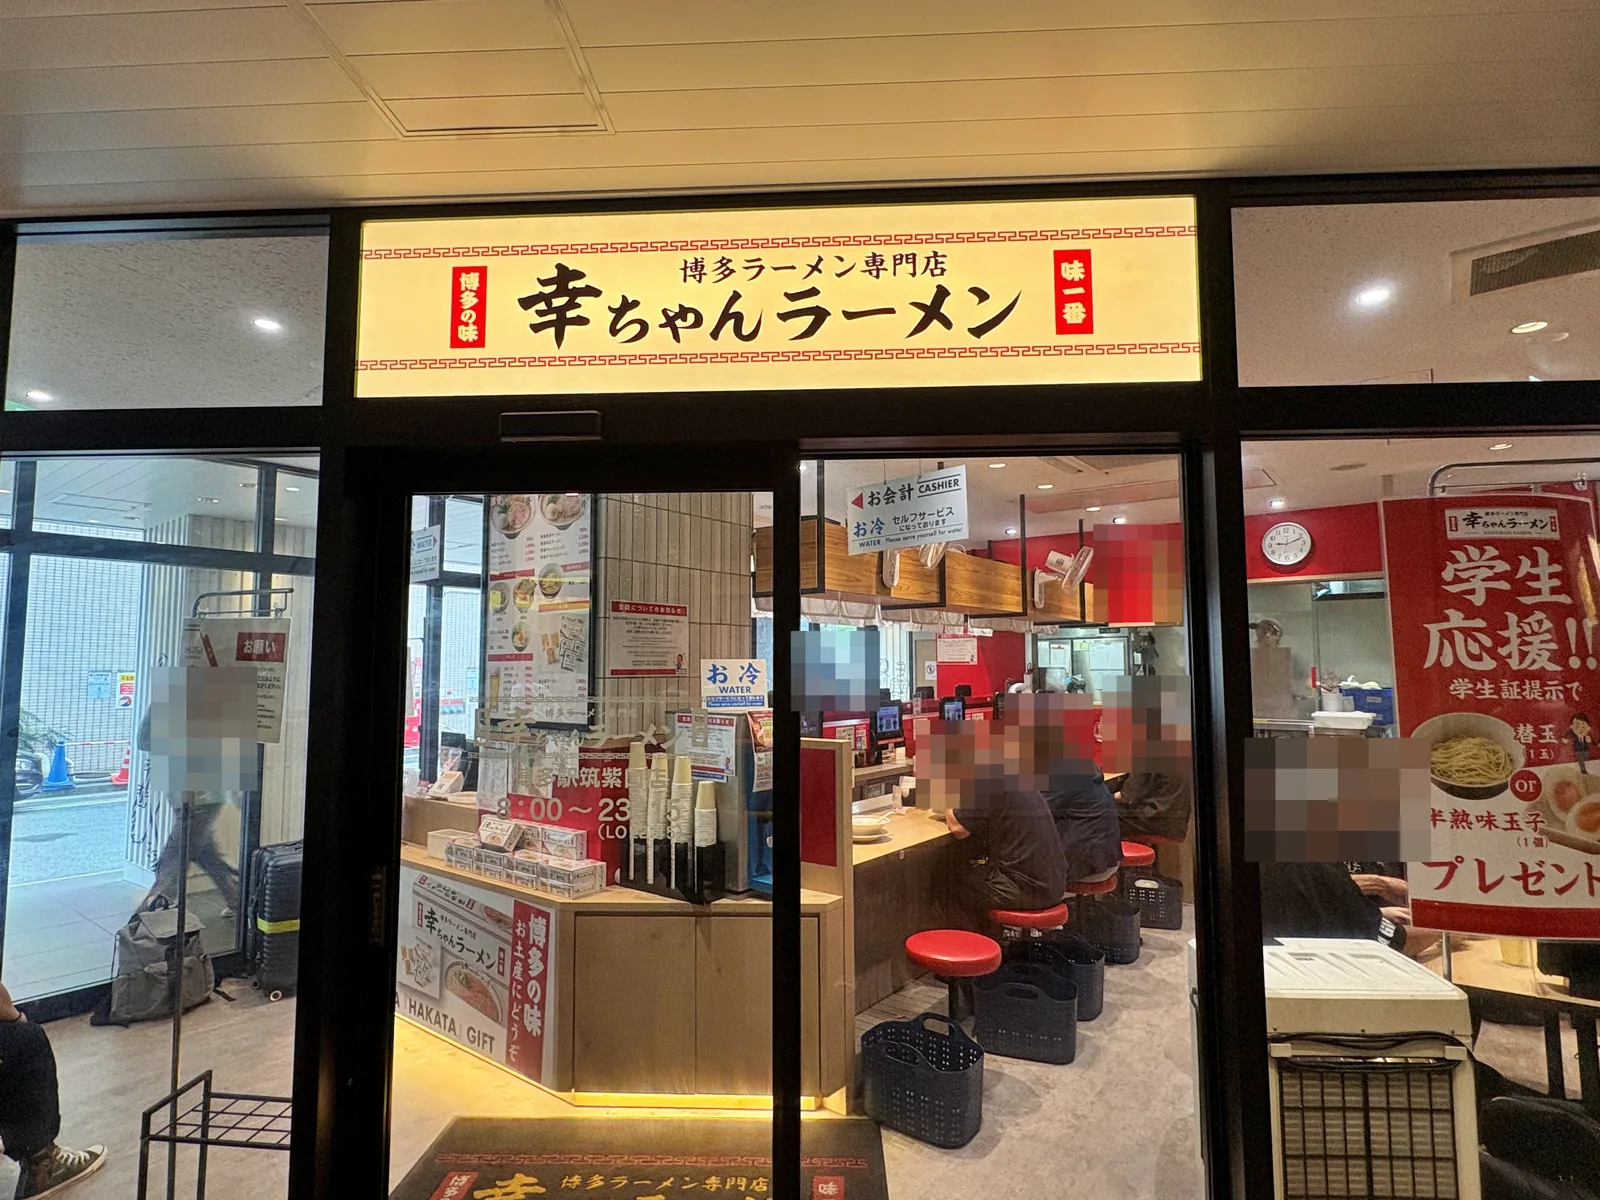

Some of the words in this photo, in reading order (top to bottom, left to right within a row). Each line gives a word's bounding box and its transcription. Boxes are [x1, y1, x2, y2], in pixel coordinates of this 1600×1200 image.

[679, 250, 948, 285] 博多ラーメン専門店
[1060, 259, 1086, 327] 味一番
[458, 271, 479, 344] 博多の味
[517, 262, 1022, 351] 幸ちゃんラーメン
[867, 483, 915, 507] お会計
[918, 478, 960, 494] CASHIER
[892, 506, 955, 525] セルフサービス
[899, 518, 947, 532] になっております
[1462, 511, 1549, 530] 幸ちゃんラーメン
[853, 517, 885, 538] お冷
[916, 530, 937, 540] yourself
[859, 539, 881, 548] WATER
[1441, 544, 1573, 607] 学生
[243, 639, 276, 654] お願い
[719, 686, 751, 694] WATER
[1449, 677, 1583, 701] 学生証提示で
[1515, 722, 1559, 744] 替玉
[1515, 779, 1537, 794] or
[1421, 855, 1600, 897] プレゼント
[424, 907, 496, 971] 幸ちゃんラーメン
[523, 912, 548, 1038] 博多の味
[508, 919, 526, 1062] お土産にどうぞ
[466, 1026, 495, 1054] GIFT
[560, 1173, 770, 1191] 博多ラーメン専門店
